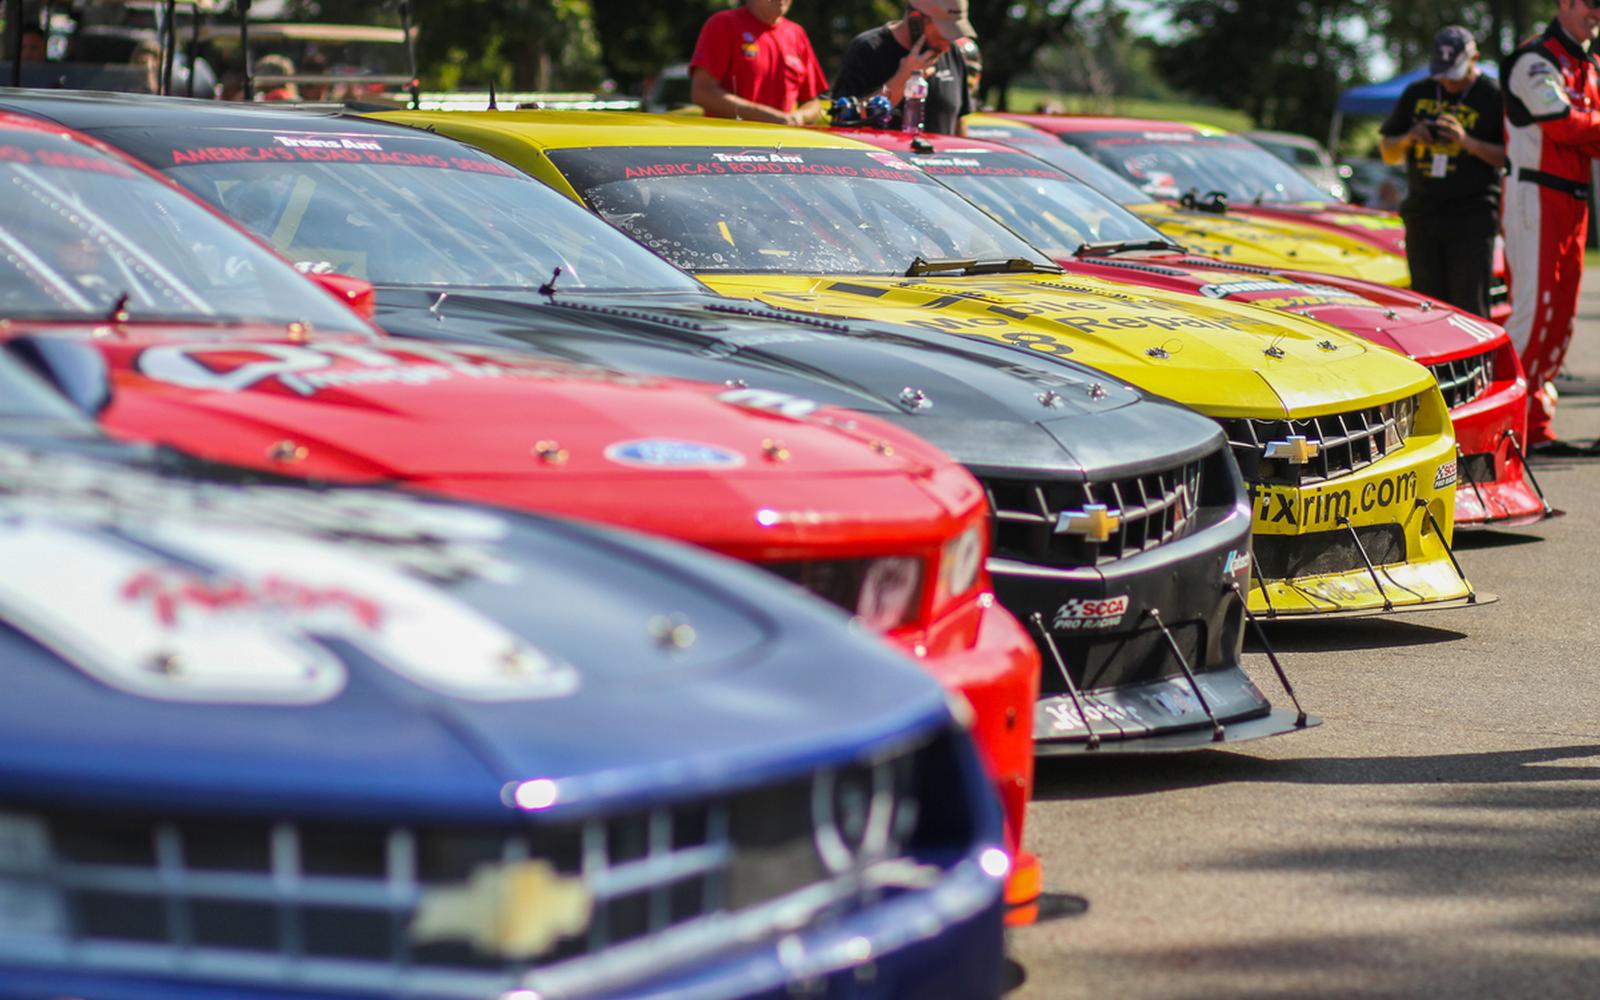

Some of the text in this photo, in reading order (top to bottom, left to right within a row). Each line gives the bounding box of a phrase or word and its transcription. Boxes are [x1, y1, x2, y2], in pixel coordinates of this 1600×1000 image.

[273, 136, 383, 150] Trans Am
[172, 146, 294, 164] AMERICA'S
[296, 147, 361, 162] ROAD
[363, 149, 448, 168] RACING
[713, 153, 804, 163] Trans Am
[625, 162, 726, 178] AMERICA'S
[728, 162, 782, 174] ROAD
[786, 163, 858, 177] RACING
[1447, 313, 1496, 343] 10
[1247, 470, 1417, 527] fixrim.com
[1083, 599, 1125, 616] SCCA
[1054, 615, 1123, 630] PRO RACING
